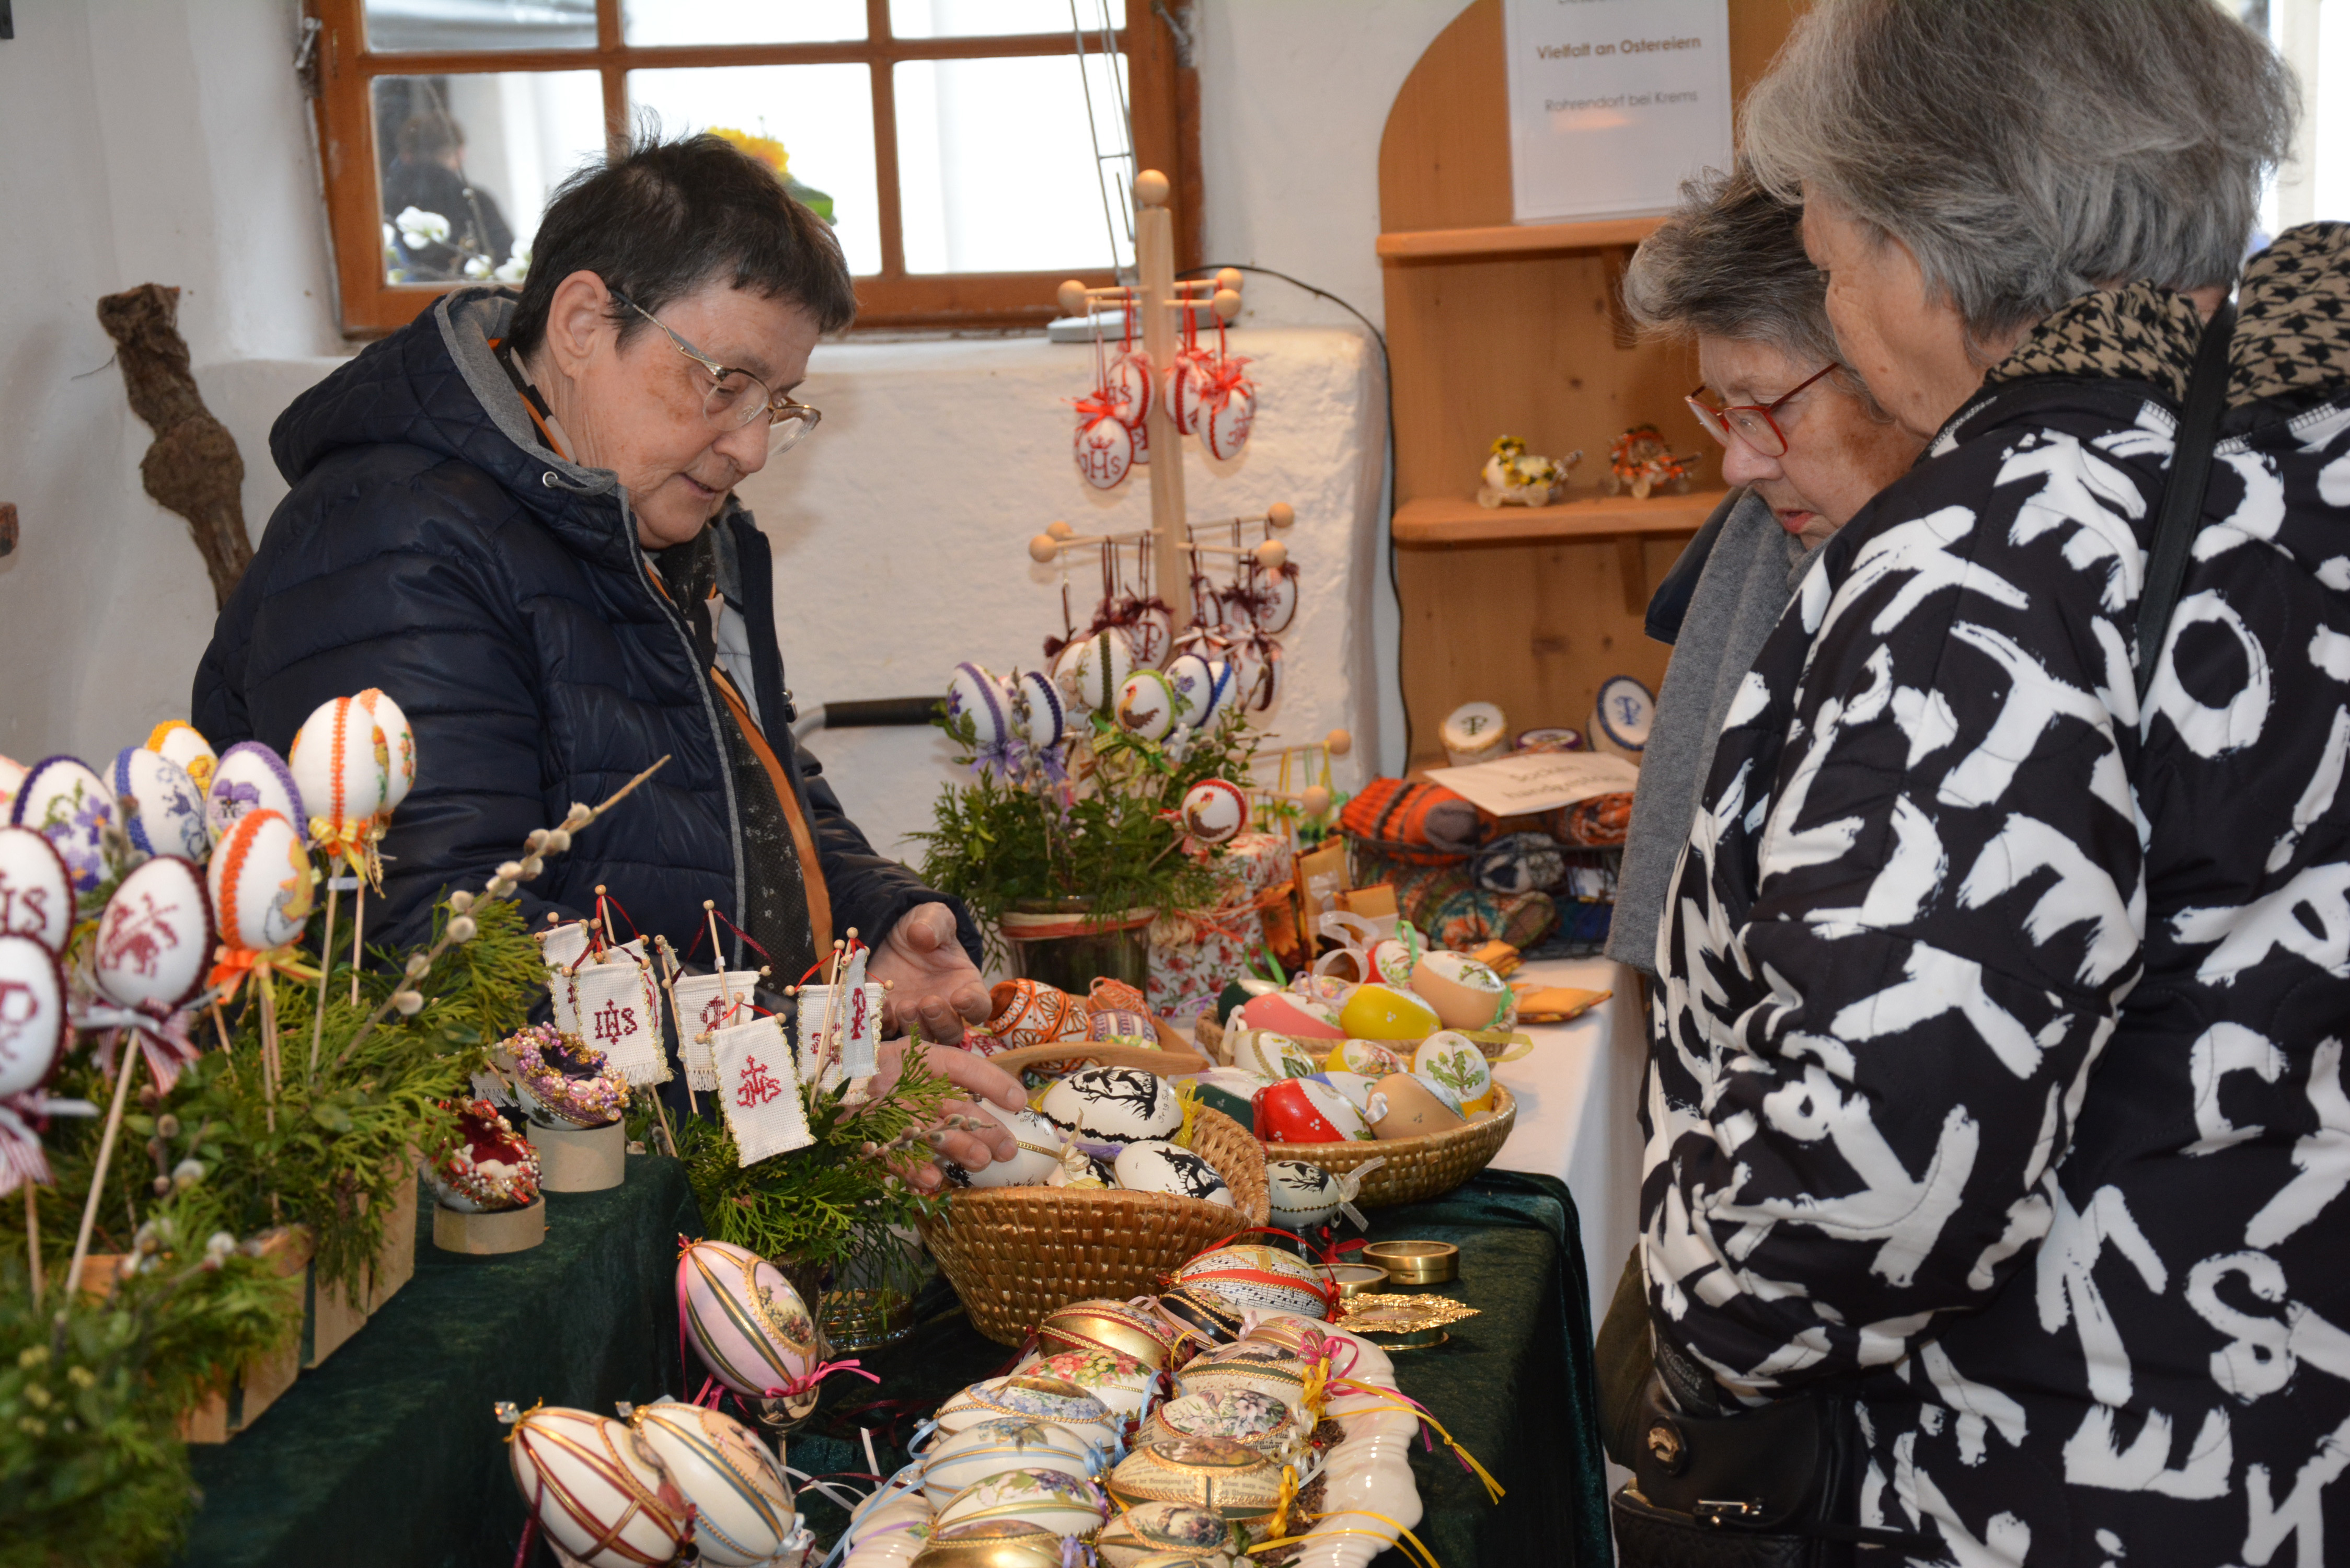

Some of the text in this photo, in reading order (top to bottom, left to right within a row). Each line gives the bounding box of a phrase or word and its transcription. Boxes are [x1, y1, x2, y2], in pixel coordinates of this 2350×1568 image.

[1536, 36, 1701, 59] Vielfalt an Ostereiern
[1628, 93, 1651, 106] bei
[1655, 90, 1698, 103] Krems
